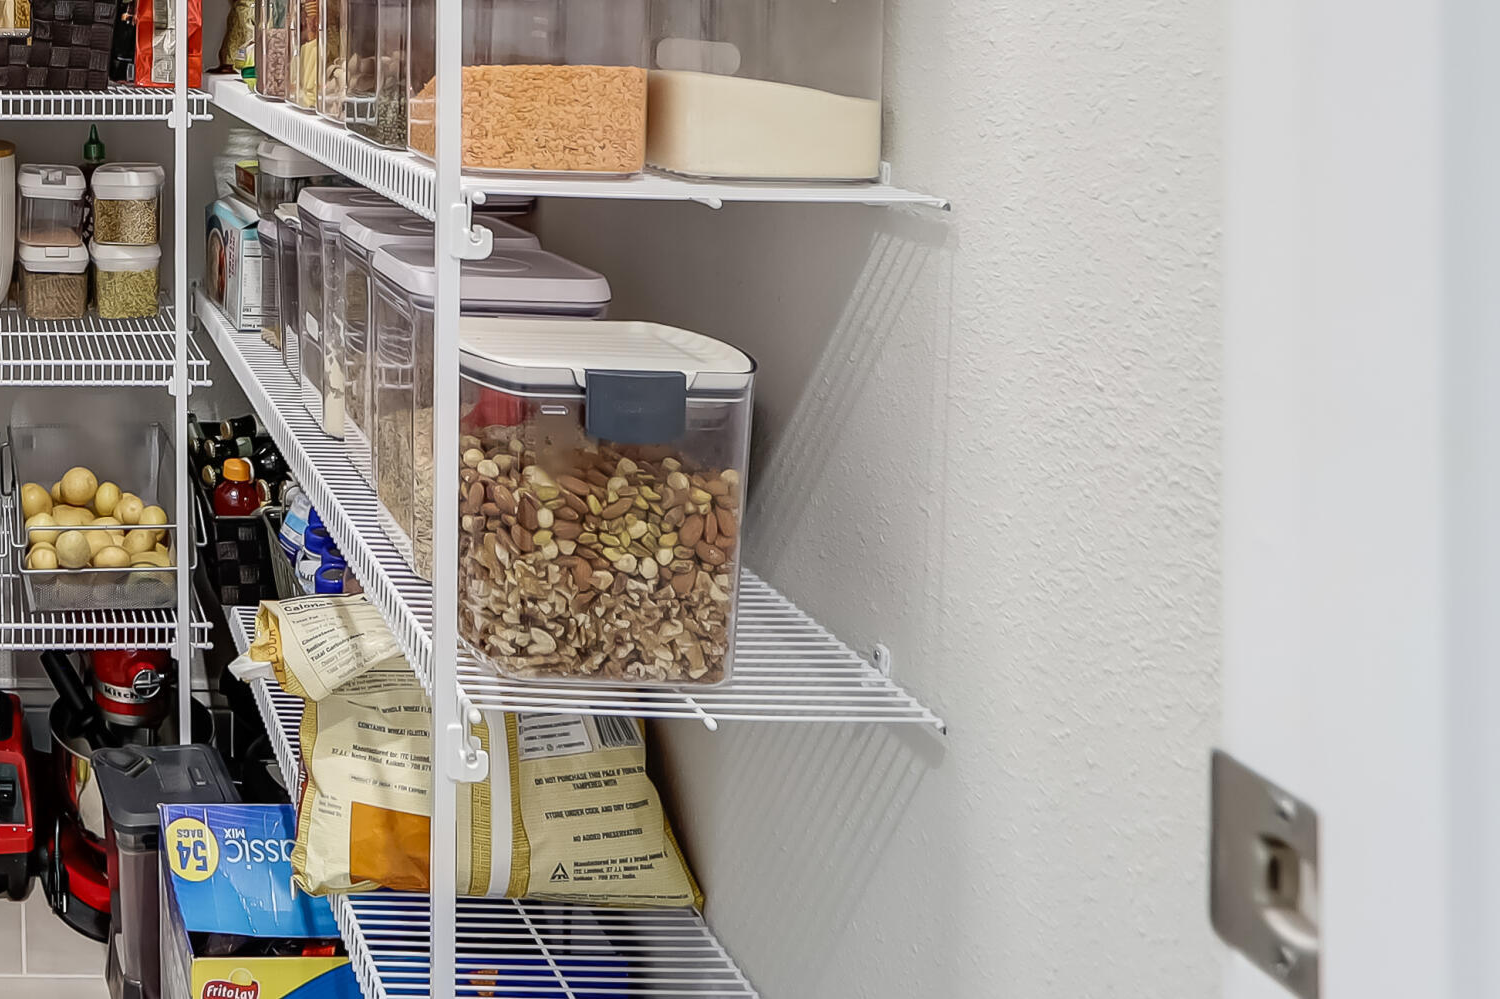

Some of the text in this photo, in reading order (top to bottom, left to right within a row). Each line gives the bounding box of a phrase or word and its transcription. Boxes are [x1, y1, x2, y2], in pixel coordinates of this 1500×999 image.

[104, 685, 139, 700] Kitch
[387, 727, 406, 736] WHEAT
[557, 771, 588, 783] PURCHASE
[588, 770, 601, 779] THIS
[572, 778, 618, 790] TAMPERED WITH
[544, 810, 565, 820] STORE
[565, 807, 585, 818] UNDER
[601, 805, 613, 814] AND
[613, 803, 625, 812] DRY
[176, 828, 204, 838] BAGS
[223, 827, 246, 840] MIX
[573, 835, 582, 843] NO
[582, 832, 601, 842] ADDED
[175, 839, 208, 872] 54
[573, 857, 610, 868] Manufactured
